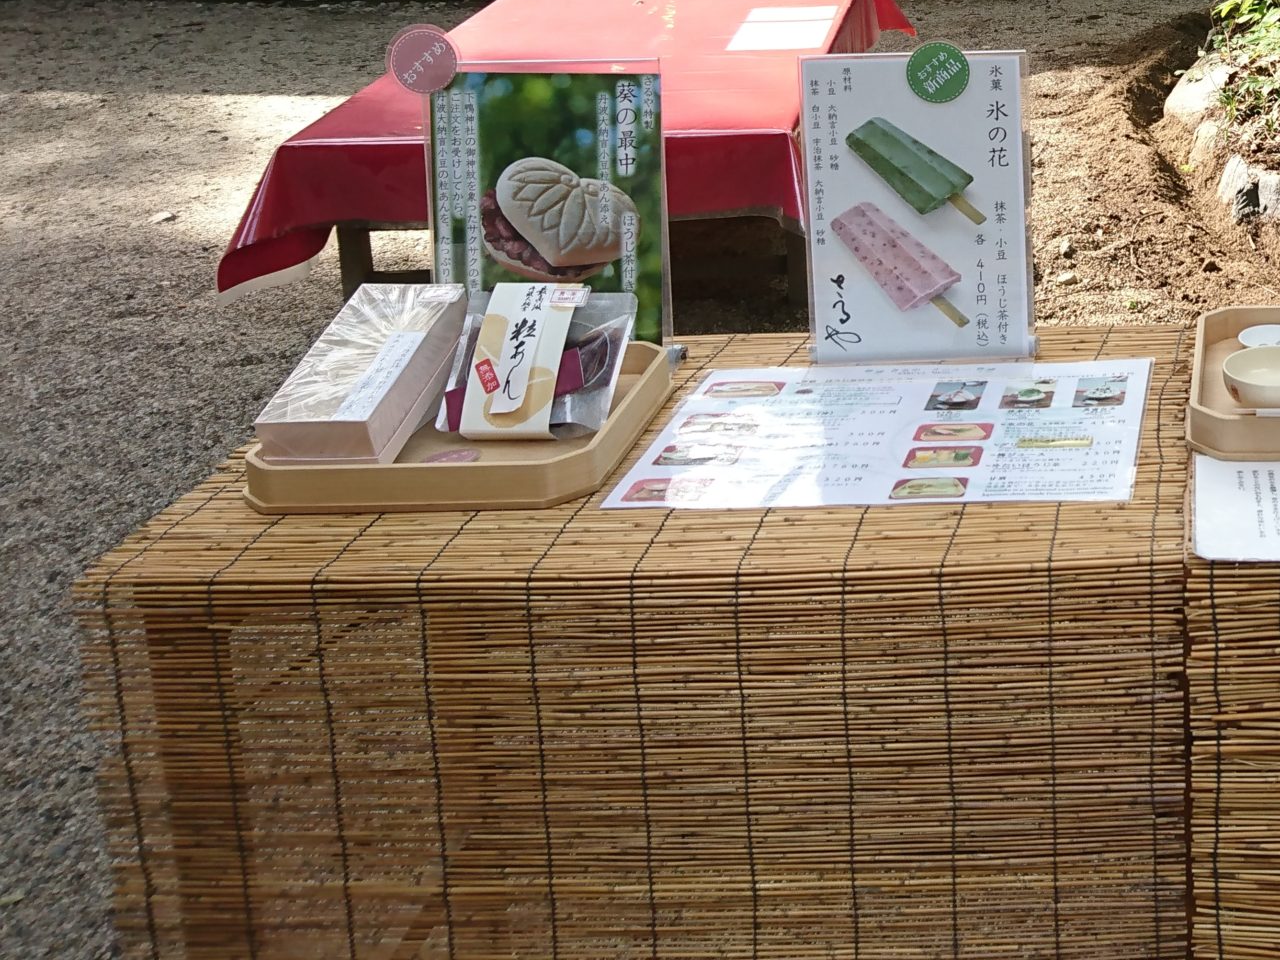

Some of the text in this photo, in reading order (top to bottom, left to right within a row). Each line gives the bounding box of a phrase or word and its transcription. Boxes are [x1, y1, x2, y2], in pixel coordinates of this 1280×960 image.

[403, 41, 447, 85] おすすめ
[917, 51, 948, 81] おすすめ
[923, 60, 963, 94] 新商品
[989, 64, 1004, 92] 氷菓
[826, 79, 836, 96] 小豆
[616, 82, 639, 175] 葵の最中
[986, 100, 1010, 168] 氷の花
[464, 93, 480, 297] 下鴨神社の御神紋を象ったサクサクの香
[622, 215, 636, 292] ほうじ茶付き
[975, 233, 985, 245] 各
[997, 274, 1009, 345] ほうじ茶付き
